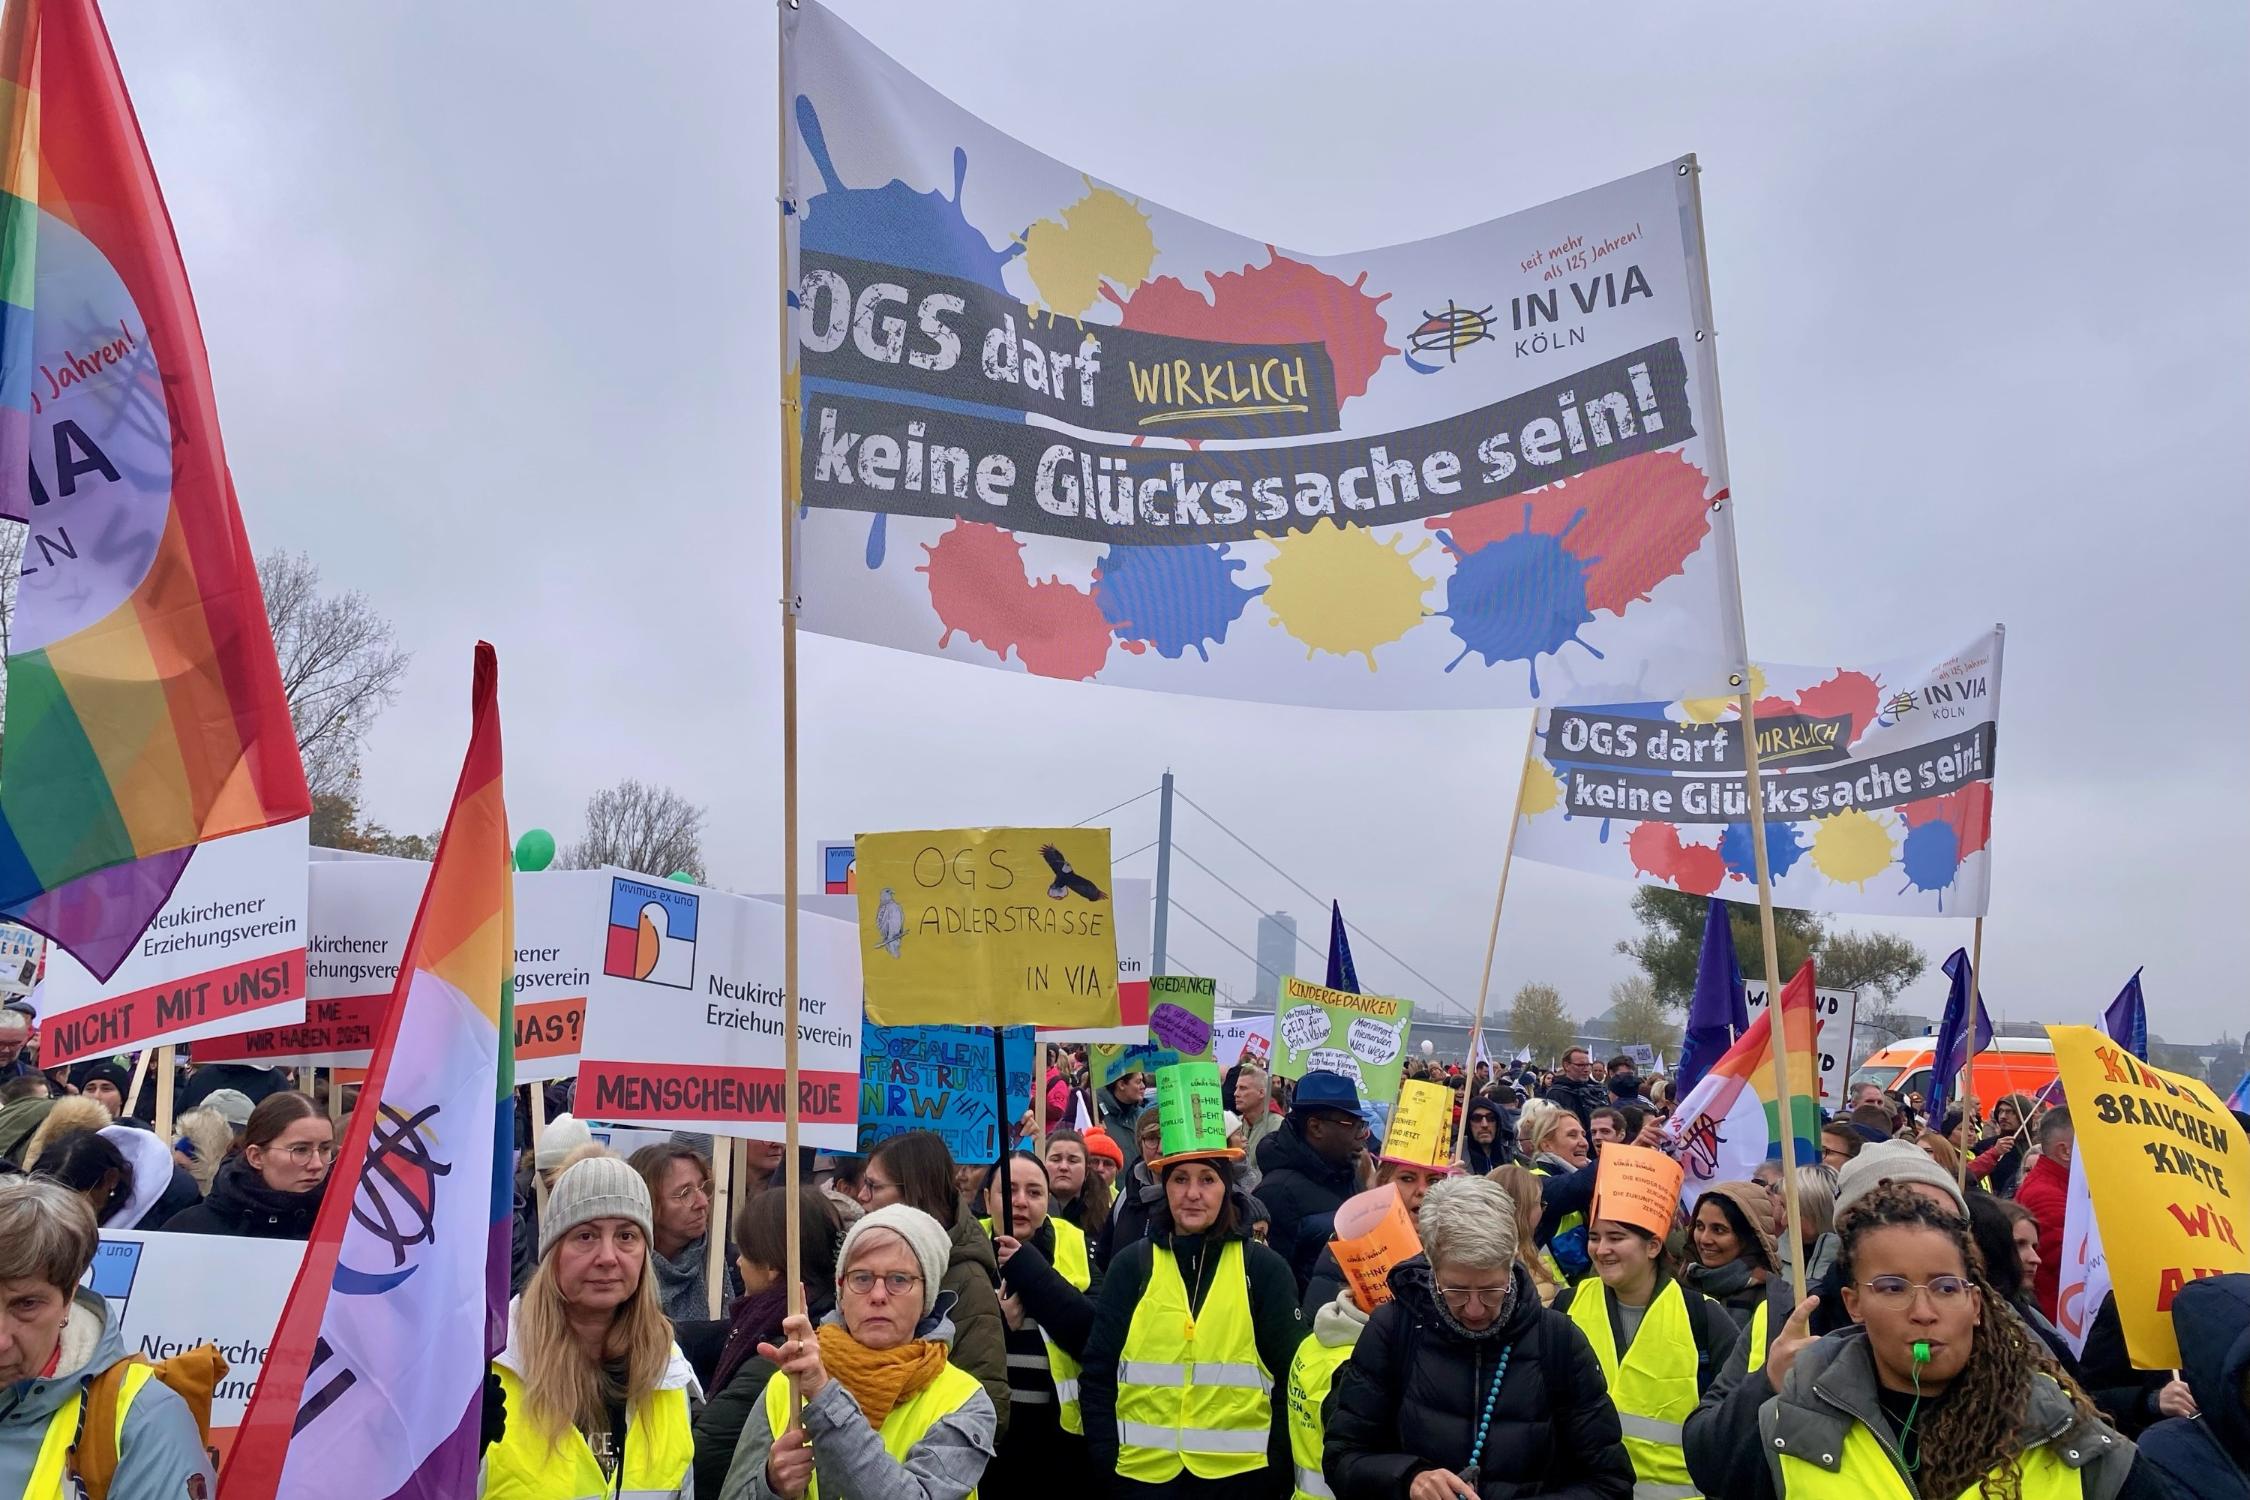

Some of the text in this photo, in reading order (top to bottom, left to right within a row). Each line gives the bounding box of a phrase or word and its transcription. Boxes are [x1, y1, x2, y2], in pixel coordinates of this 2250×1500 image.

[1521, 235, 1583, 273] seit mehr
[1544, 222, 1644, 281] als 125 Jahren!
[1512, 264, 1654, 330] IN VIA
[799, 269, 1308, 407] OGS darf WIRKLICH
[1515, 326, 1585, 358] KÖLN
[40, 320, 136, 399] Jahren!
[815, 361, 1664, 527] keine Glückssache sein!
[1924, 676, 1987, 705] IN VIA
[1932, 706, 1965, 719] KÖLN
[1561, 717, 1637, 759] OGS
[1647, 727, 1729, 763] darf
[1575, 773, 1673, 813] keine
[1918, 733, 1983, 789] sein!
[913, 846, 1015, 891] OGS
[618, 881, 694, 908] vivimus ex uno
[144, 916, 296, 958] Erziehungsverein
[919, 906, 1104, 937] ADLERSTRASSE
[709, 974, 827, 1016] Neukirchner
[1027, 964, 1049, 992] IN
[1064, 964, 1102, 999] VIA
[1288, 978, 1397, 1016] KINDERGEDANKEN
[54, 1003, 134, 1058] NICHT
[156, 982, 211, 1028] MIT
[706, 1003, 853, 1049] Erziehunsverein
[1227, 1027, 1246, 1039] die
[1281, 1018, 1305, 1037] GELD
[596, 1073, 842, 1114] MENSCHENWRDE
[862, 1083, 997, 1131] NRW HAT
[2094, 1093, 2229, 1154] BRAUCHEN
[2143, 1142, 2231, 1199] KNETE
[106, 1245, 133, 1258] uno
